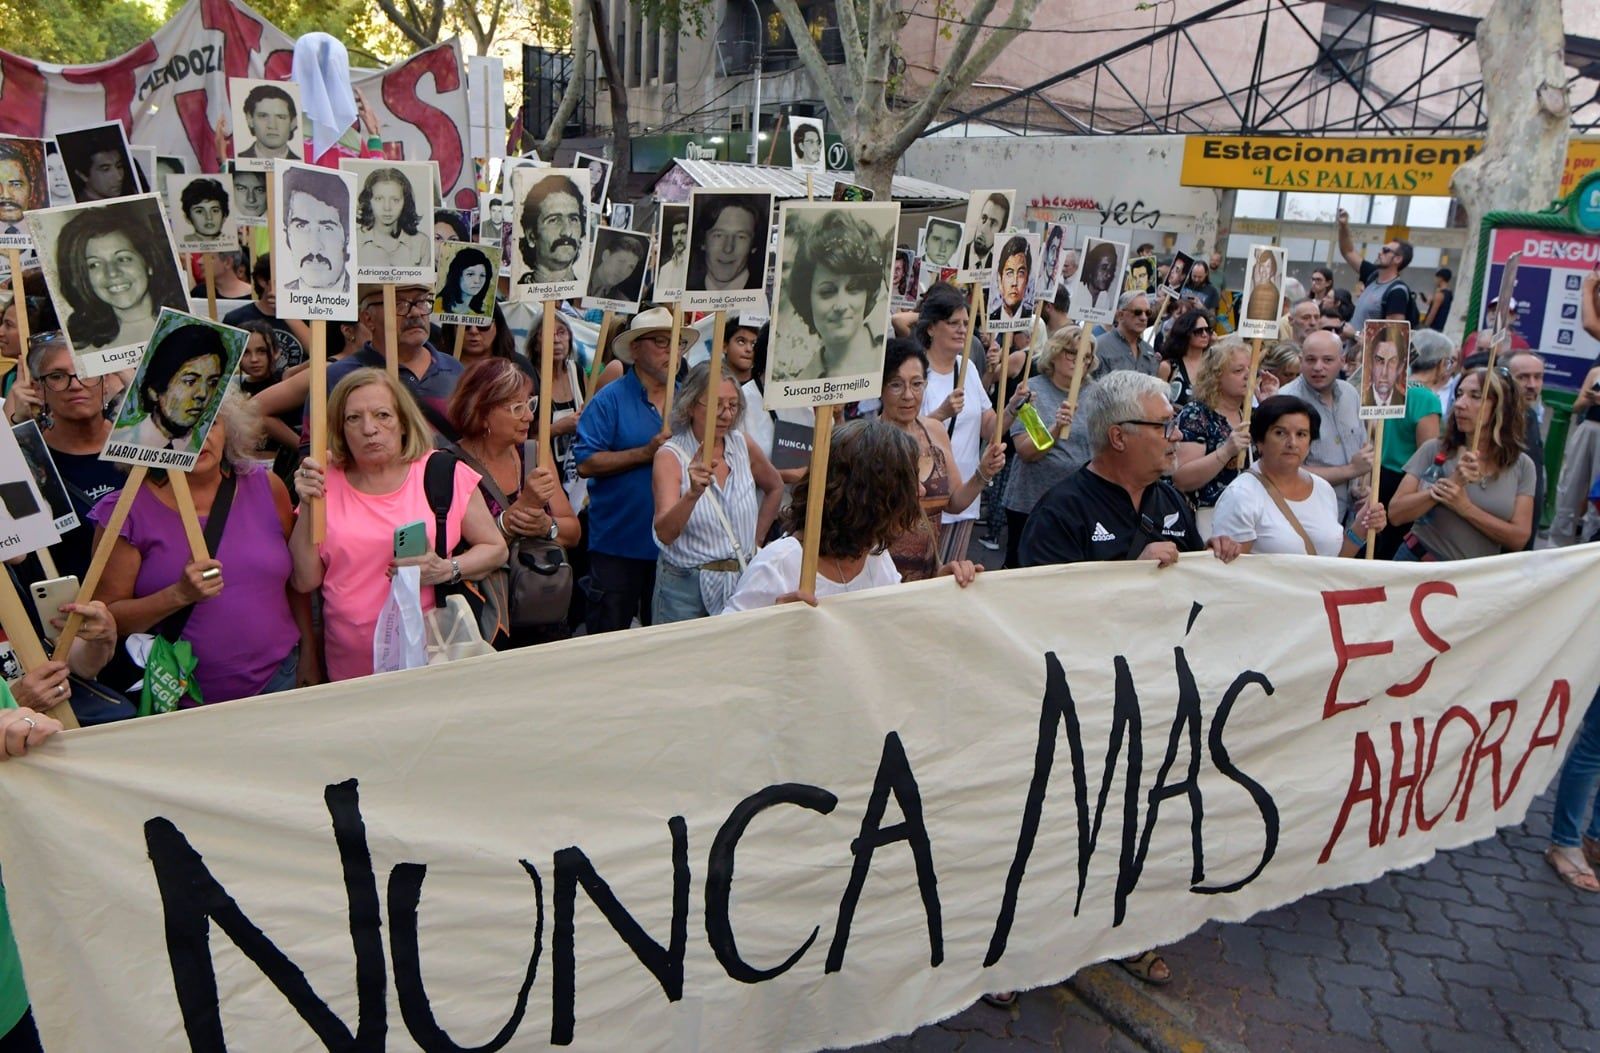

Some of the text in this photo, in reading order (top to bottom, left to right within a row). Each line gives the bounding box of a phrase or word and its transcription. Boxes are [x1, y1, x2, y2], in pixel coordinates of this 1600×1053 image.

[1203, 140, 1480, 165] Estacionamient
[1522, 239, 1600, 262] DENGU
[357, 268, 422, 276] Adriana Campos
[527, 286, 552, 294] Alfredo
[290, 292, 350, 307] Jorge Amodey
[308, 306, 334, 315] Julio-76
[461, 316, 485, 325] BENITEZ
[102, 346, 145, 363] Laura T
[783, 379, 870, 396] Susana Bermejillo
[778, 438, 806, 450] NUNCA
[105, 444, 195, 467] MARIO LUIS SANTINI
[0, 534, 21, 549] rchi
[1322, 581, 1458, 720] ES
[153, 666, 186, 697] LEGA
[150, 679, 178, 707] EGU
[1318, 679, 1571, 864] AHORA
[144, 601, 1279, 1053] NUNCA MÁS
